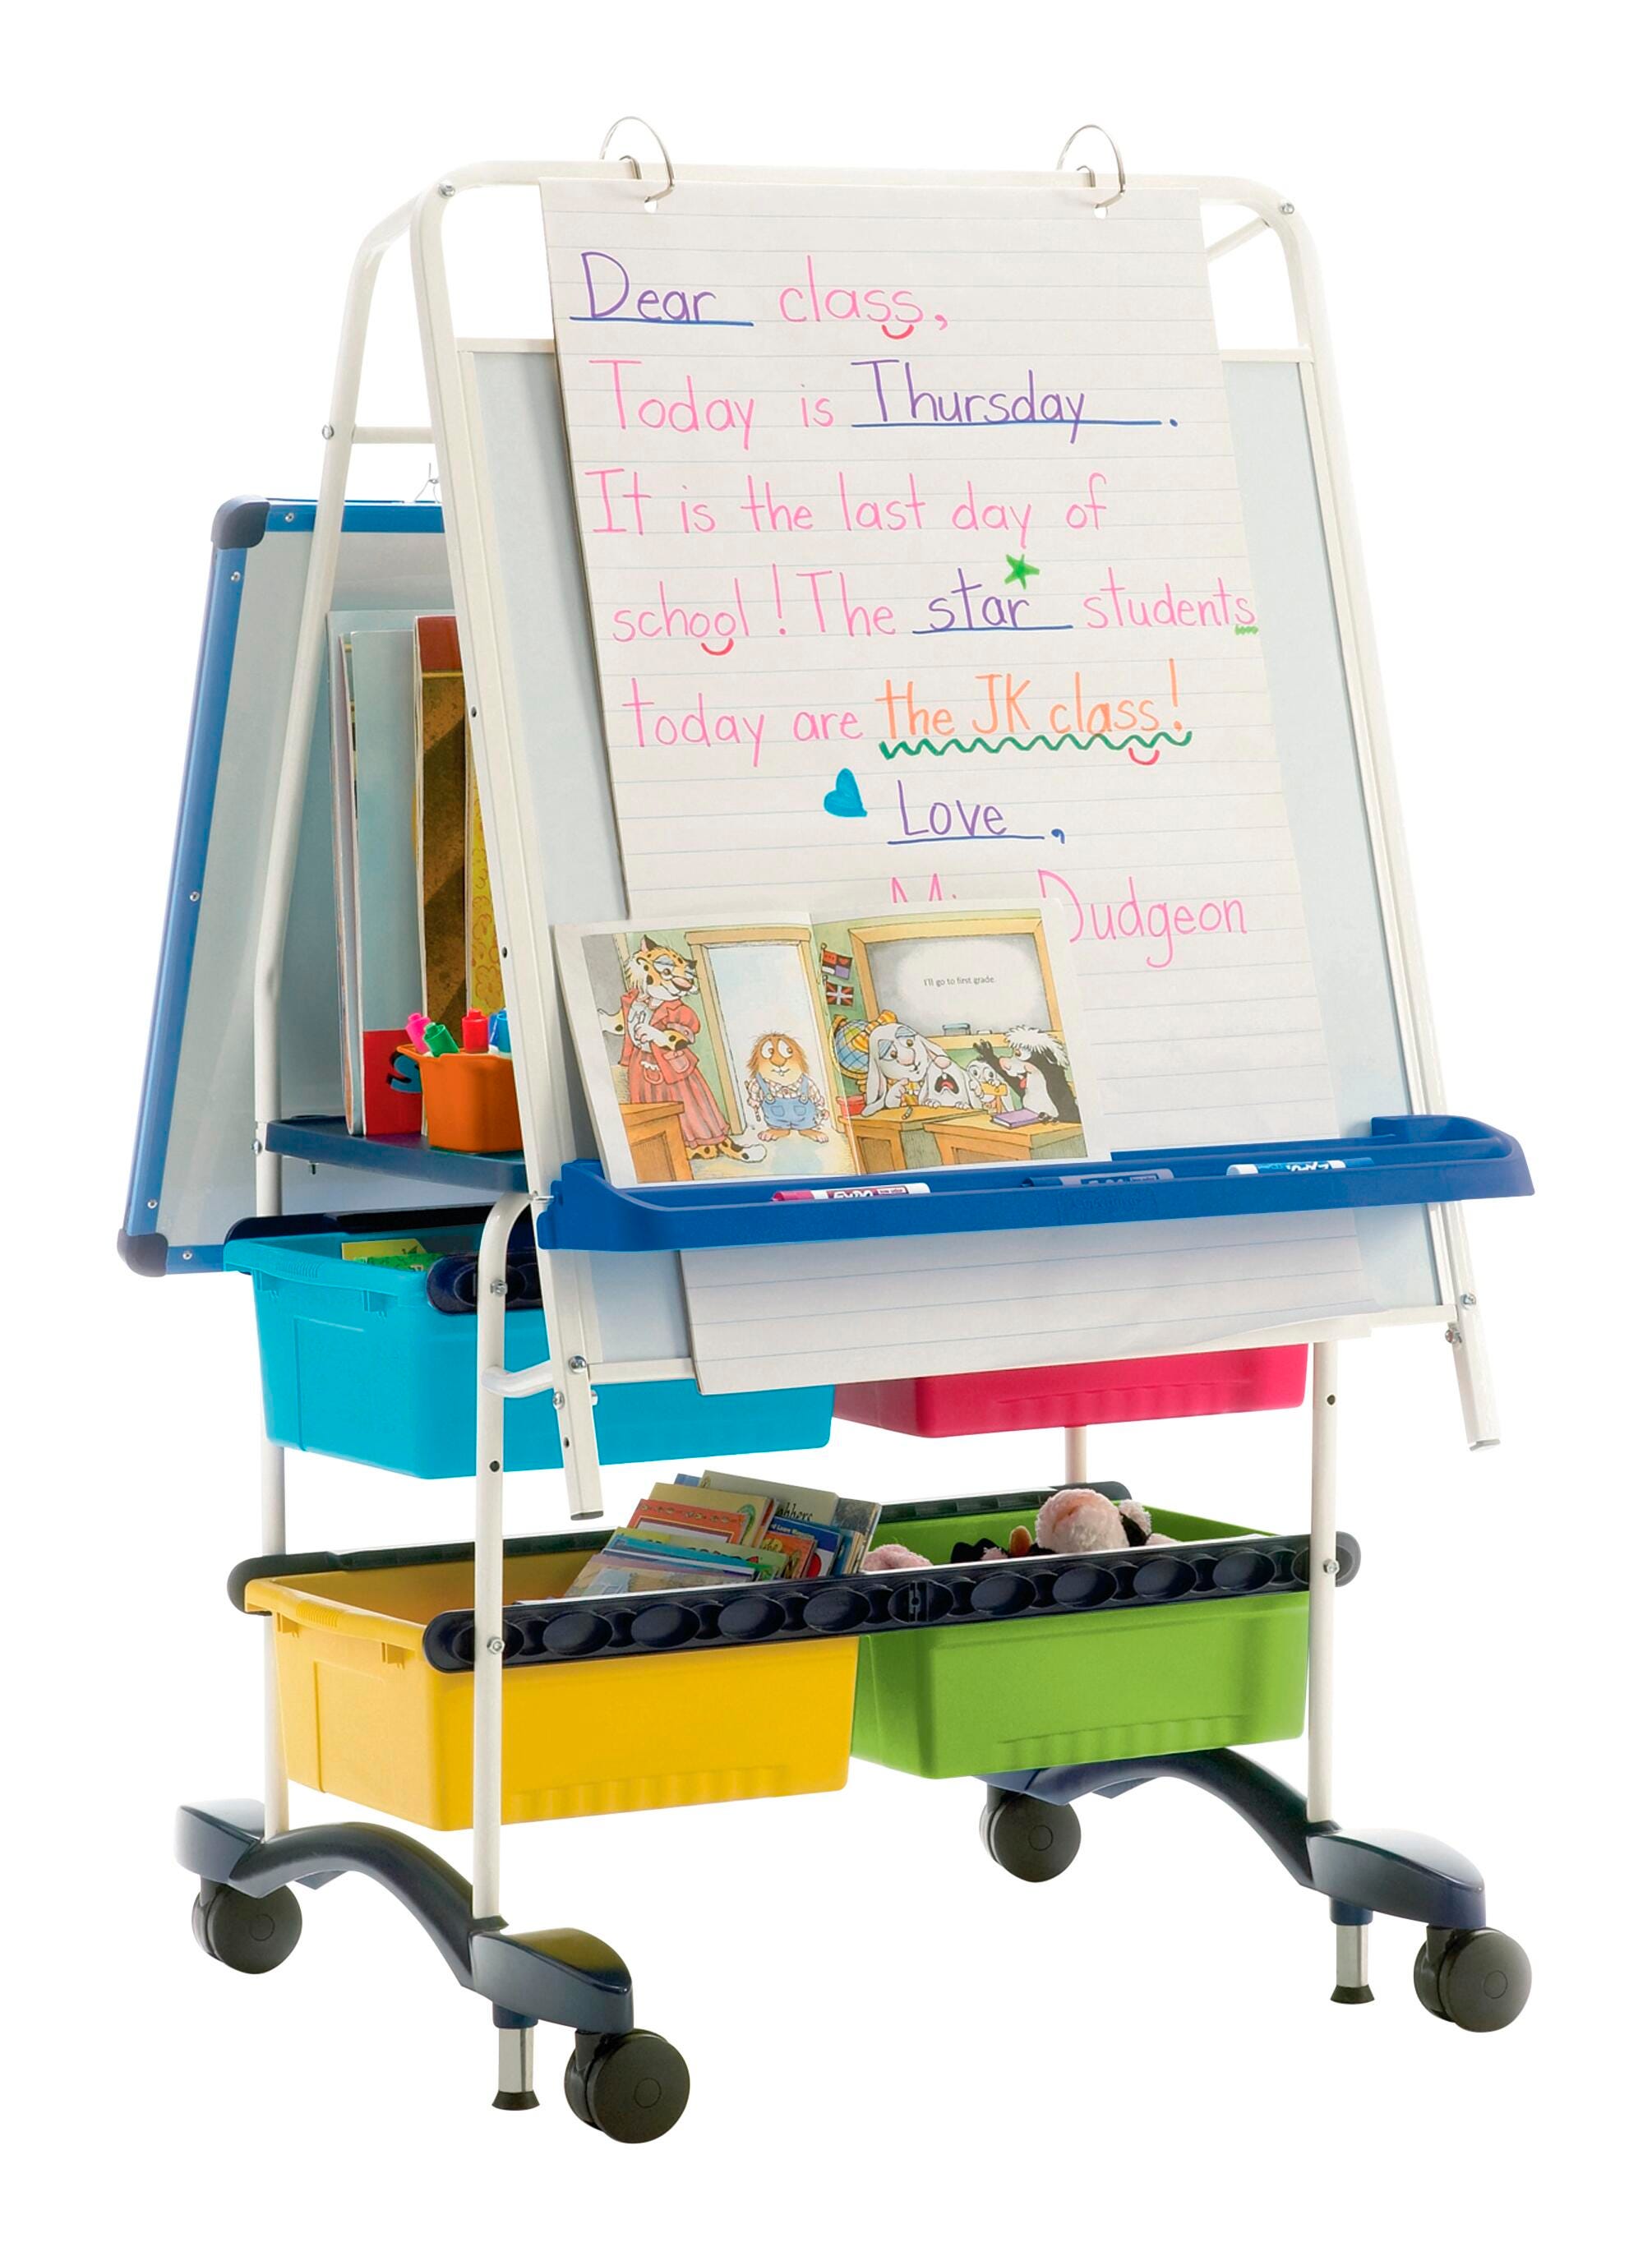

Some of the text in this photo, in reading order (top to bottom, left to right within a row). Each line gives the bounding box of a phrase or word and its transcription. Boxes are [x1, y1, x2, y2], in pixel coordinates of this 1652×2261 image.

[580, 251, 948, 330] Dear class,
[588, 358, 758, 450] Today
[800, 382, 834, 428] is
[585, 467, 1108, 549] It is the last day of
[796, 570, 897, 636] The
[927, 567, 1031, 630] star
[1082, 566, 1257, 630] students
[792, 708, 865, 741] are
[874, 678, 957, 741] the
[970, 672, 1033, 738] JK
[1048, 657, 1184, 736] class!
[935, 978, 946, 987] go
[946, 977, 956, 985] to
[956, 976, 971, 985] first
